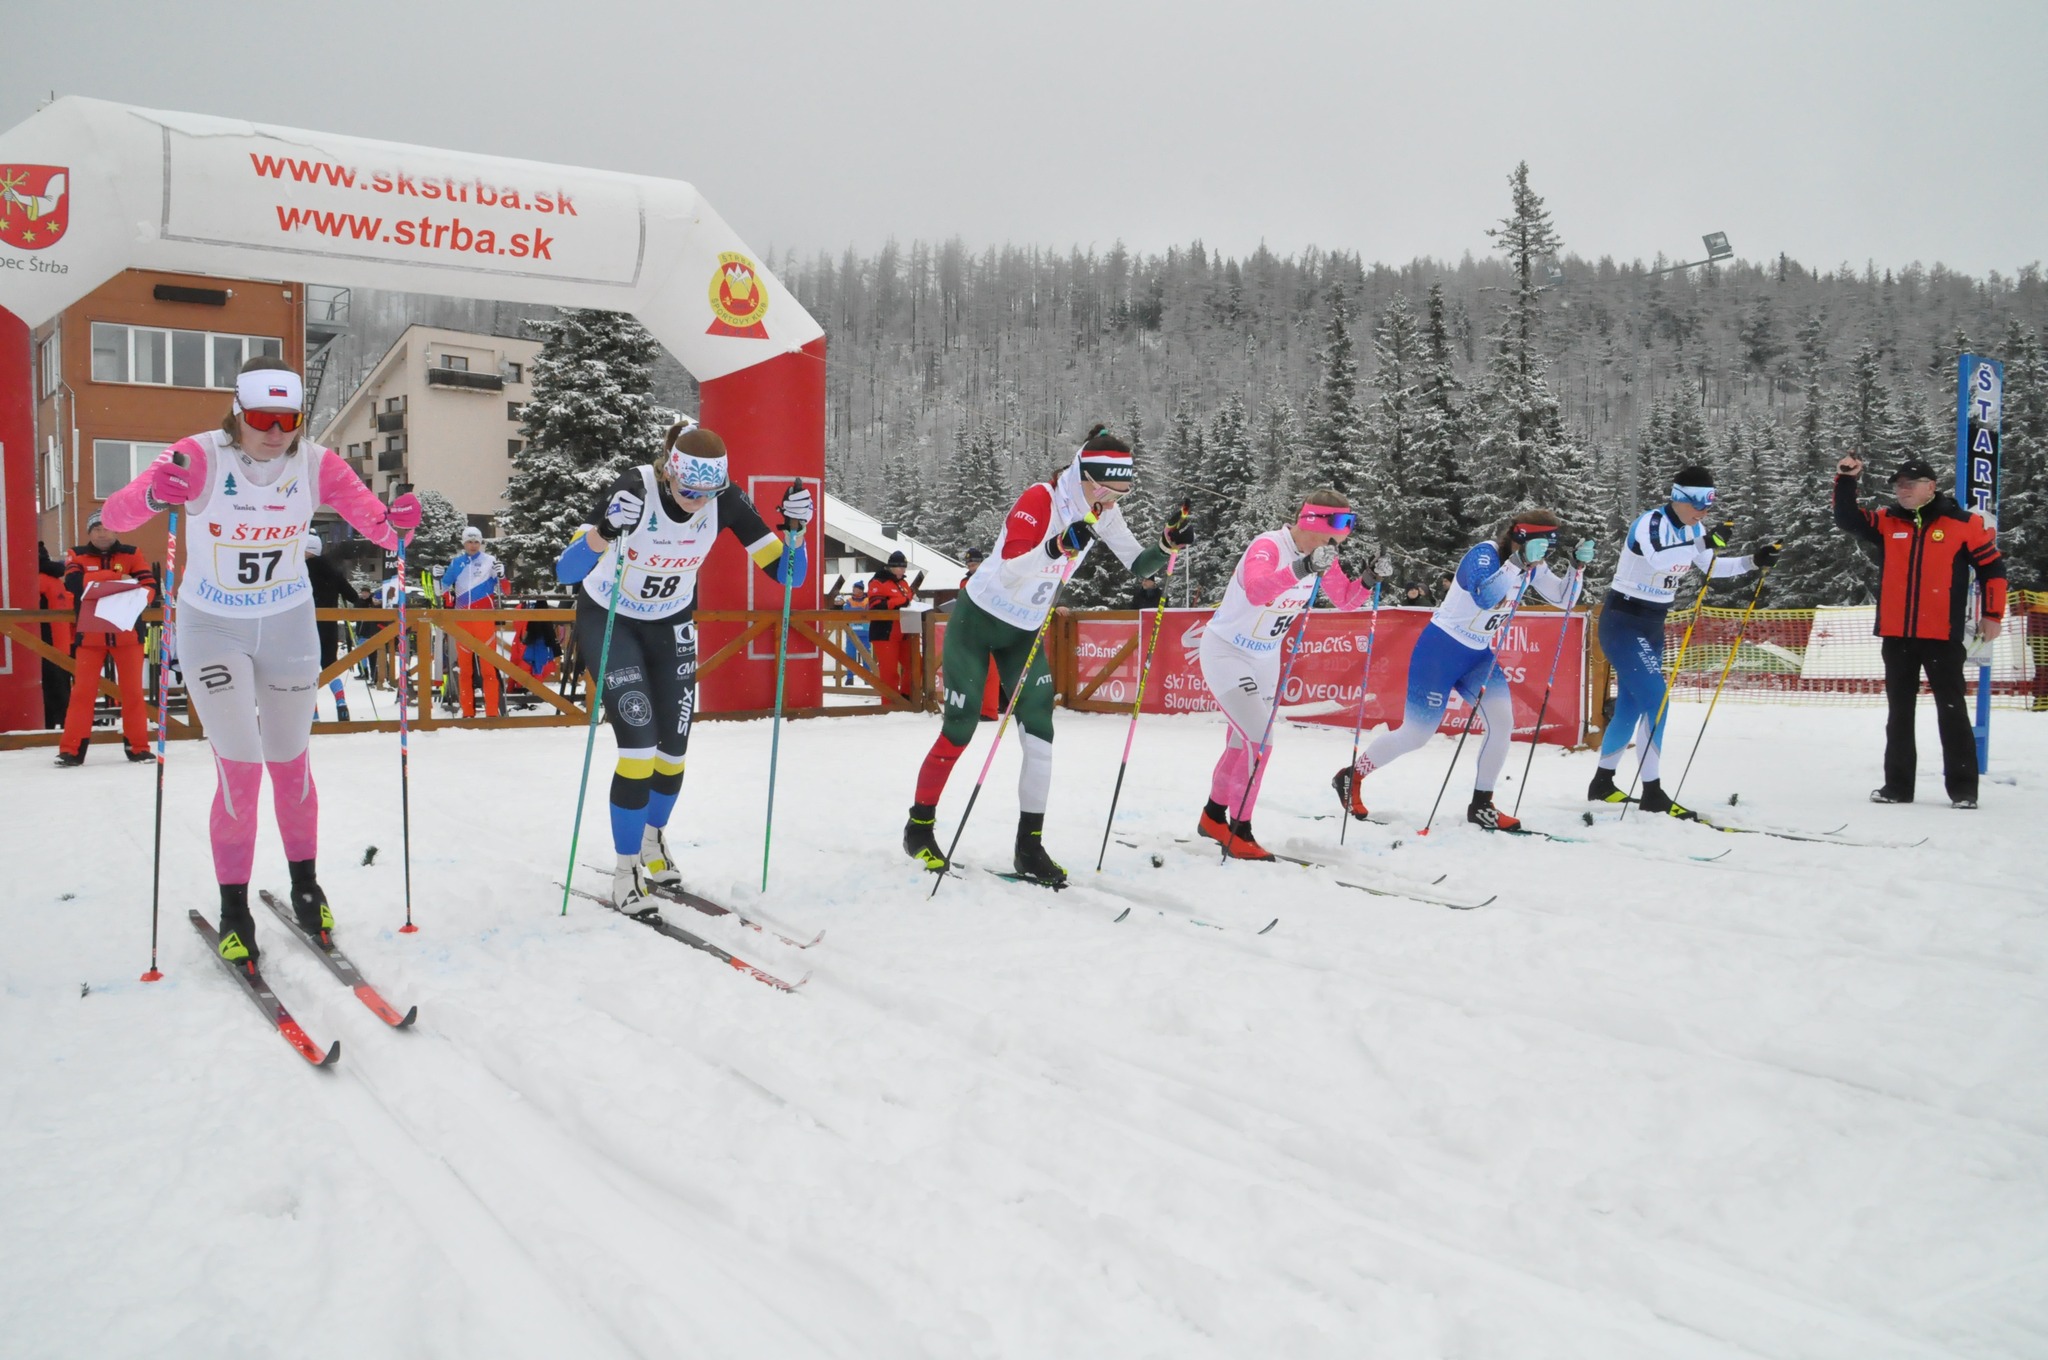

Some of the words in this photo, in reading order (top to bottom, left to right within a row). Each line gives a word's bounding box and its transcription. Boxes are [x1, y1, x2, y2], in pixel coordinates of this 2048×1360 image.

[249, 152, 578, 217] www.skstrba.sk
[276, 205, 554, 260] www.strba.sk
[29, 255, 69, 274] Štrba
[1973, 362, 1993, 512] ŠTART
[1014, 510, 1038, 527] ATEX
[231, 522, 307, 541] ŠTRBA
[238, 550, 283, 584] 57
[196, 577, 267, 607] ŠTRBSKÉ
[640, 575, 682, 599] 58
[1163, 673, 1184, 690] Ski
[1187, 674, 1210, 691] Tea
[1306, 684, 1363, 700] VEOLIA
[1164, 692, 1219, 711] Slovakia
